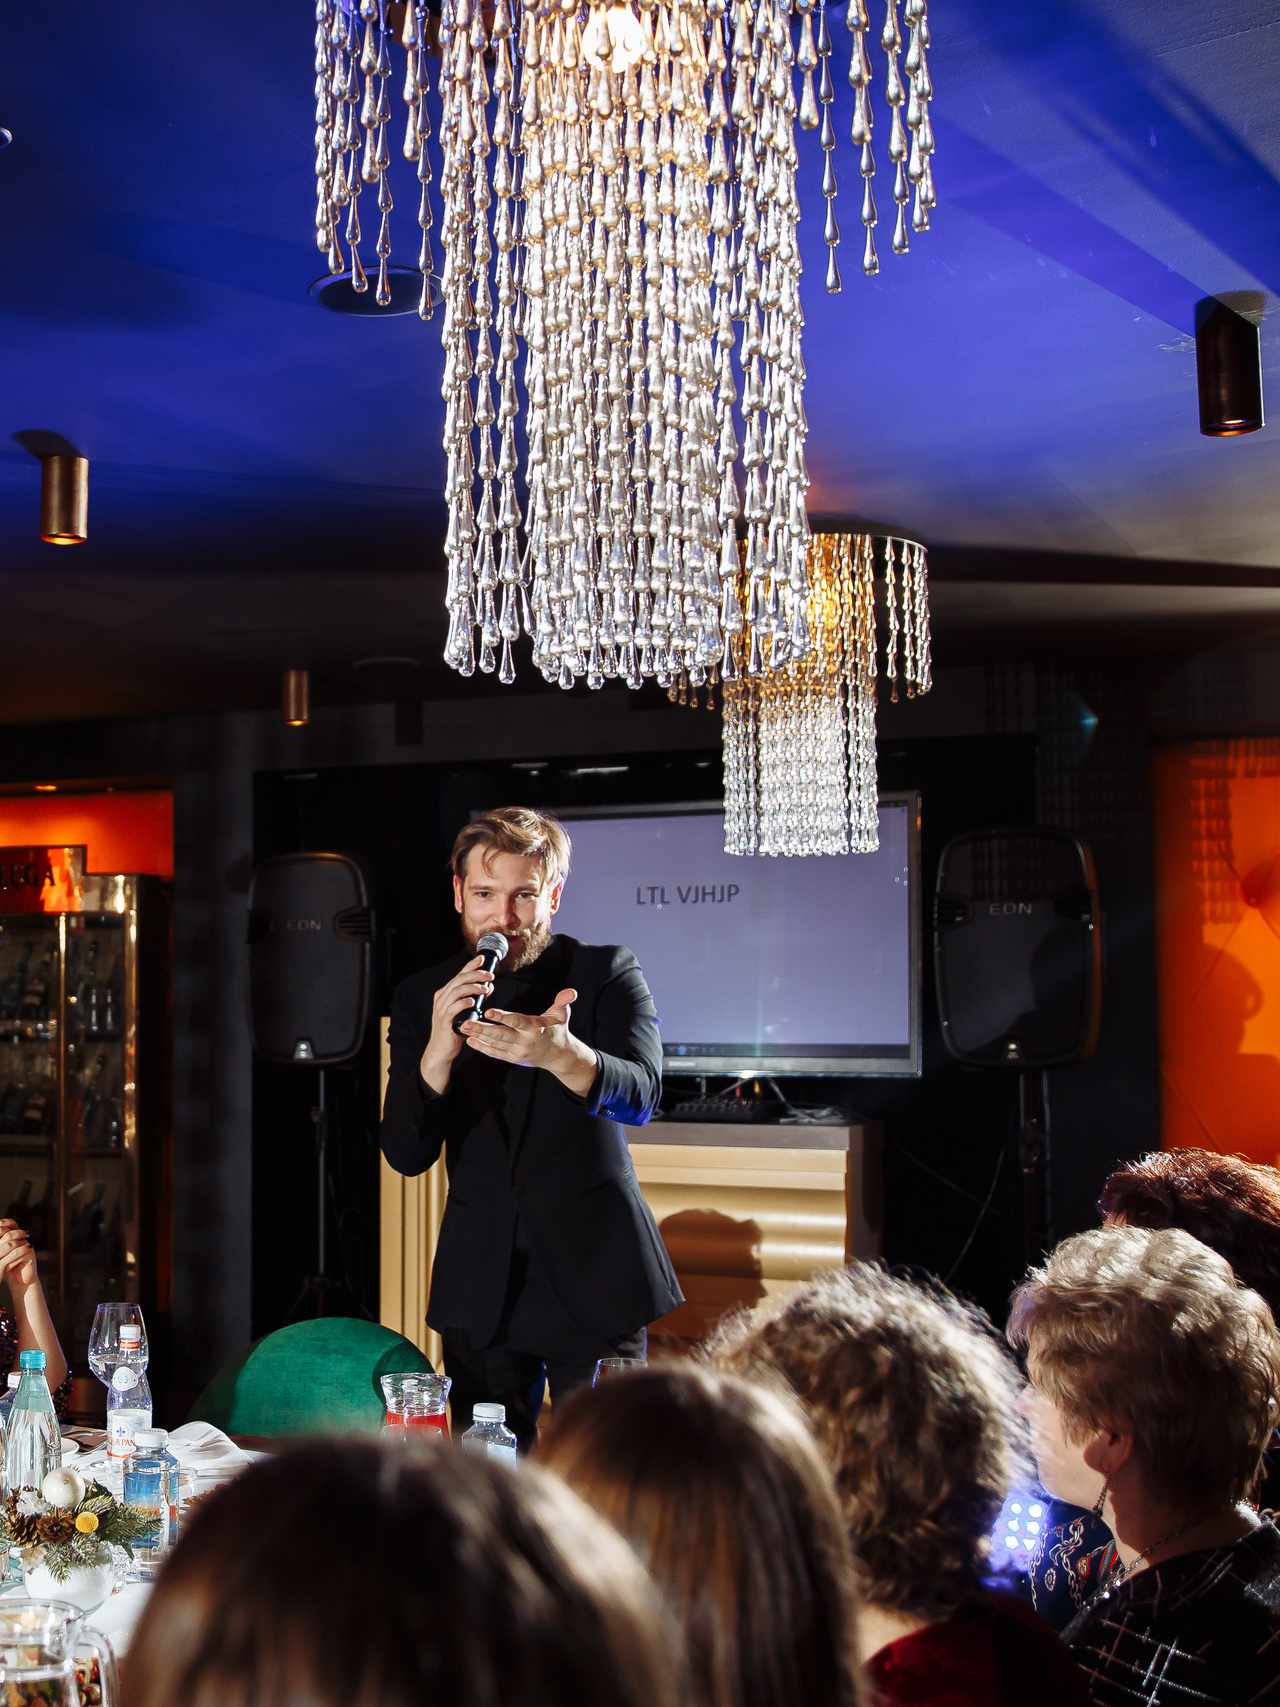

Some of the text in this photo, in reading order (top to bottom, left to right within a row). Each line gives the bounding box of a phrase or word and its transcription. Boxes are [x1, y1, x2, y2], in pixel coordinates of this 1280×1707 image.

[636, 883, 740, 904] LTL VJHJP
[989, 902, 1032, 915] EON
[287, 919, 321, 930] EON
